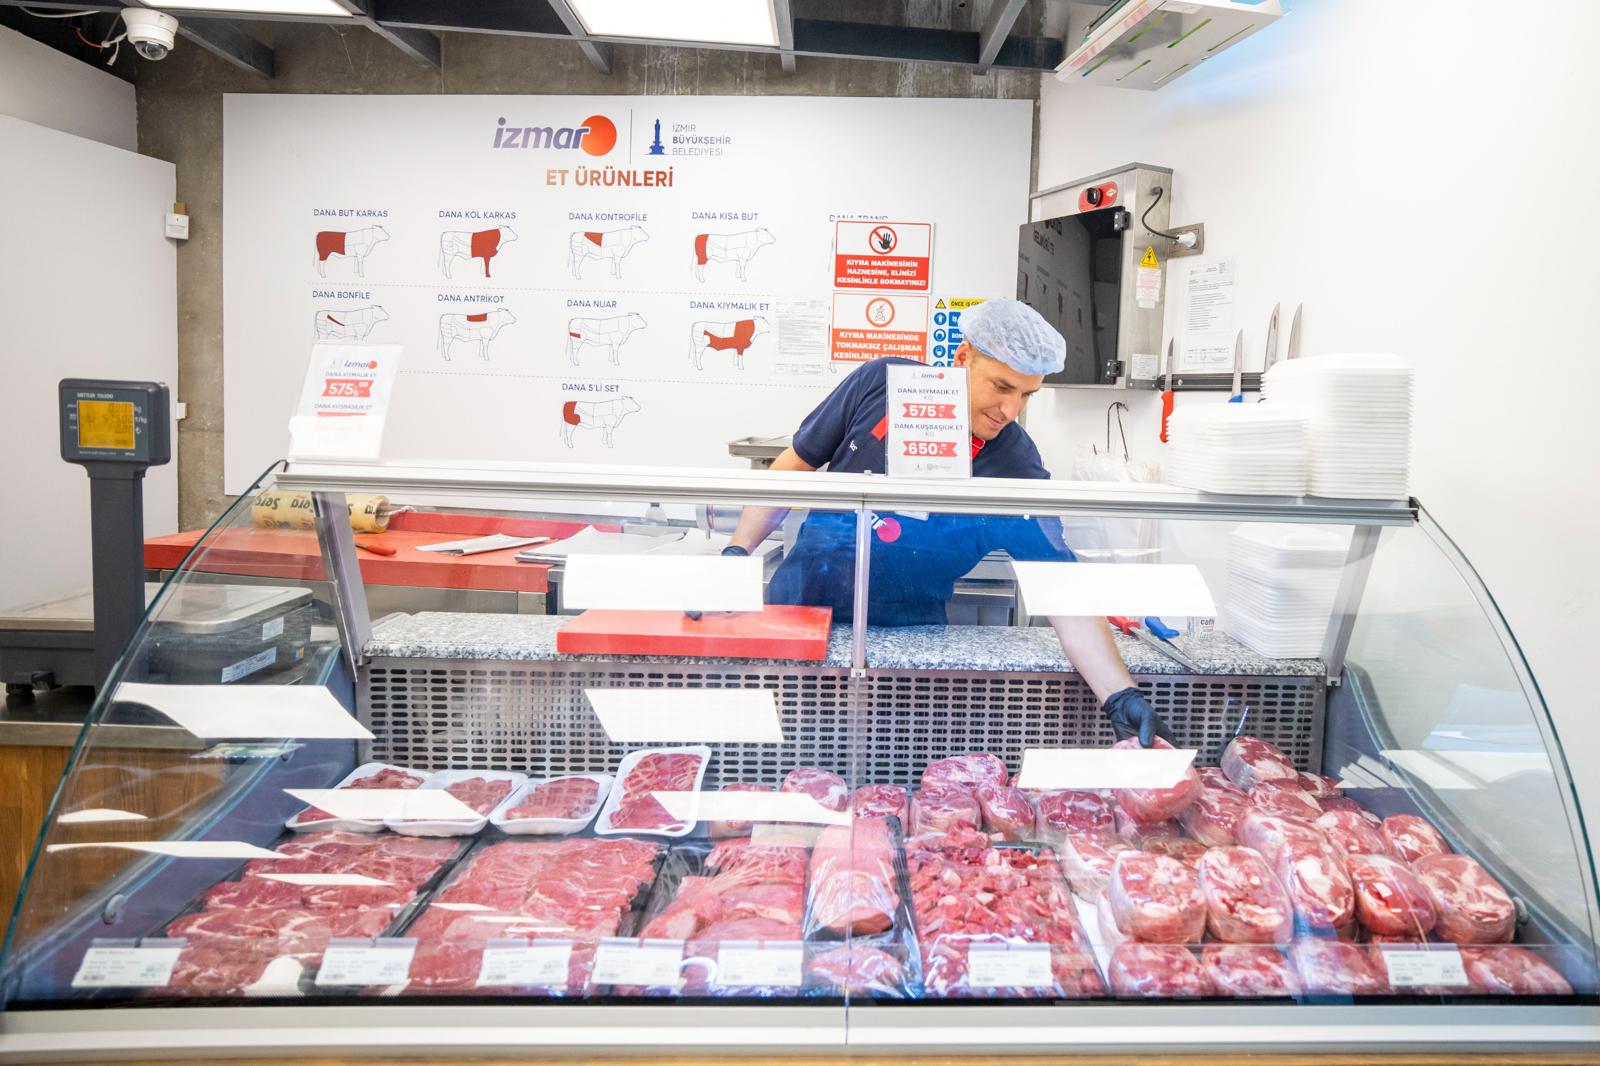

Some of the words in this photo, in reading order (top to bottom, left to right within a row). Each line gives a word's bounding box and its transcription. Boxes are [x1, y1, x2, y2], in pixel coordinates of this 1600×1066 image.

[493, 117, 589, 149] izmar
[672, 123, 697, 133] İZMİR
[672, 135, 731, 146] BÜYÜKŞEHİR
[672, 146, 723, 156] BELEDİYESİ
[546, 169, 569, 186] ET
[575, 166, 673, 187] ÜRÜNLERİ
[314, 208, 337, 217] DANA
[339, 209, 354, 217] BUT
[356, 209, 388, 218] KARKAS
[439, 210, 462, 219] DANA
[464, 210, 481, 219] KOL
[483, 211, 517, 220] KARKAS
[569, 212, 593, 221] DANA
[595, 212, 648, 222] KONTROFİLE
[692, 212, 717, 220] DANA
[719, 212, 739, 221] KISA
[741, 212, 759, 221] BUT
[846, 259, 870, 267] KIYMA
[891, 269, 917, 277] ELİNİZİ
[837, 276, 879, 285] KESİNLİKLE
[312, 290, 335, 299] DANA
[337, 290, 370, 300] BONFİLE
[438, 294, 461, 303] DANA
[463, 293, 504, 303] ANTRİKOT
[567, 299, 591, 308] DANA
[593, 300, 617, 309] NUAR
[690, 301, 715, 309] DANA
[717, 302, 757, 311] KIYMALIK
[759, 303, 770, 311] ET
[839, 331, 864, 339] KIYMA
[865, 331, 920, 342] MAKİNESİNDE
[835, 341, 881, 350] TOKMAKSIZ
[882, 342, 922, 352] ÇALIŞMAK
[562, 383, 586, 392] DANA
[604, 384, 620, 393] SET
